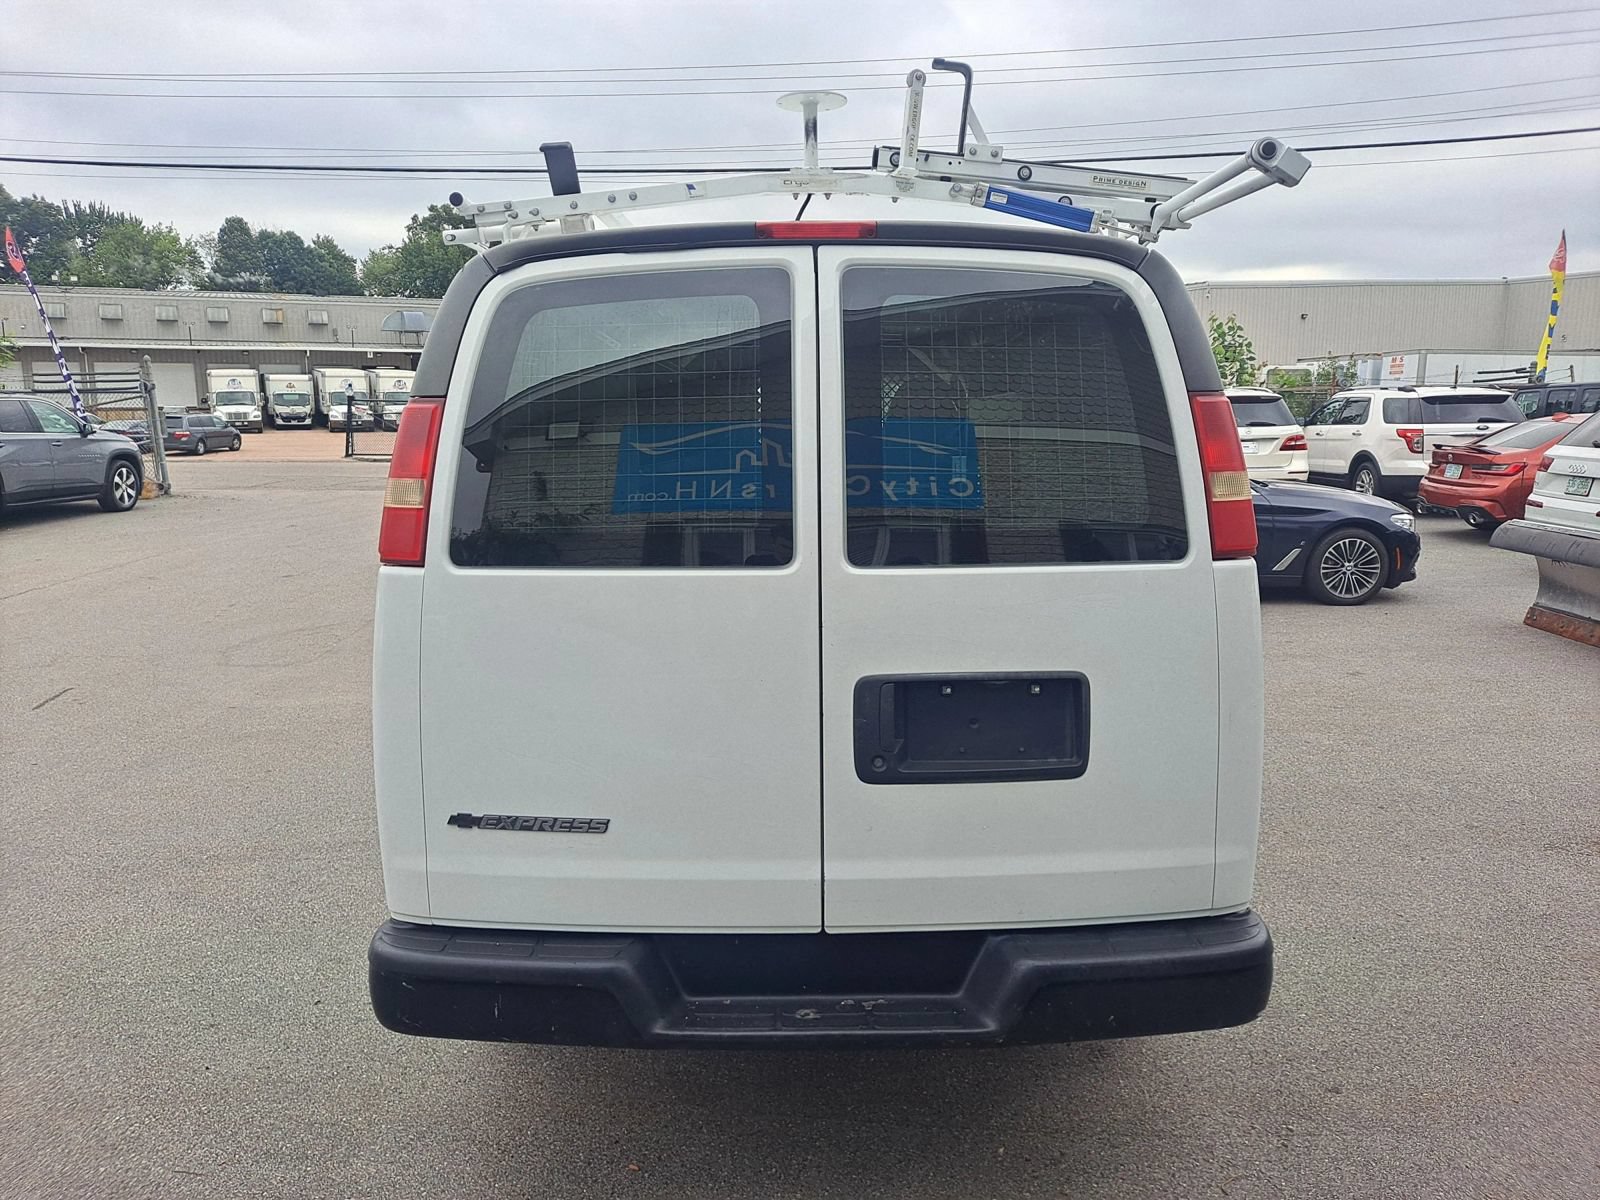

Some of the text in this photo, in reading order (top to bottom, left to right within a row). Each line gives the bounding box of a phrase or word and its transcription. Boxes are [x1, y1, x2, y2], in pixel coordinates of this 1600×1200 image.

[1092, 175, 1117, 184] PRIME
[1119, 179, 1147, 187] DESIGN
[479, 814, 608, 833] EXPRESS
